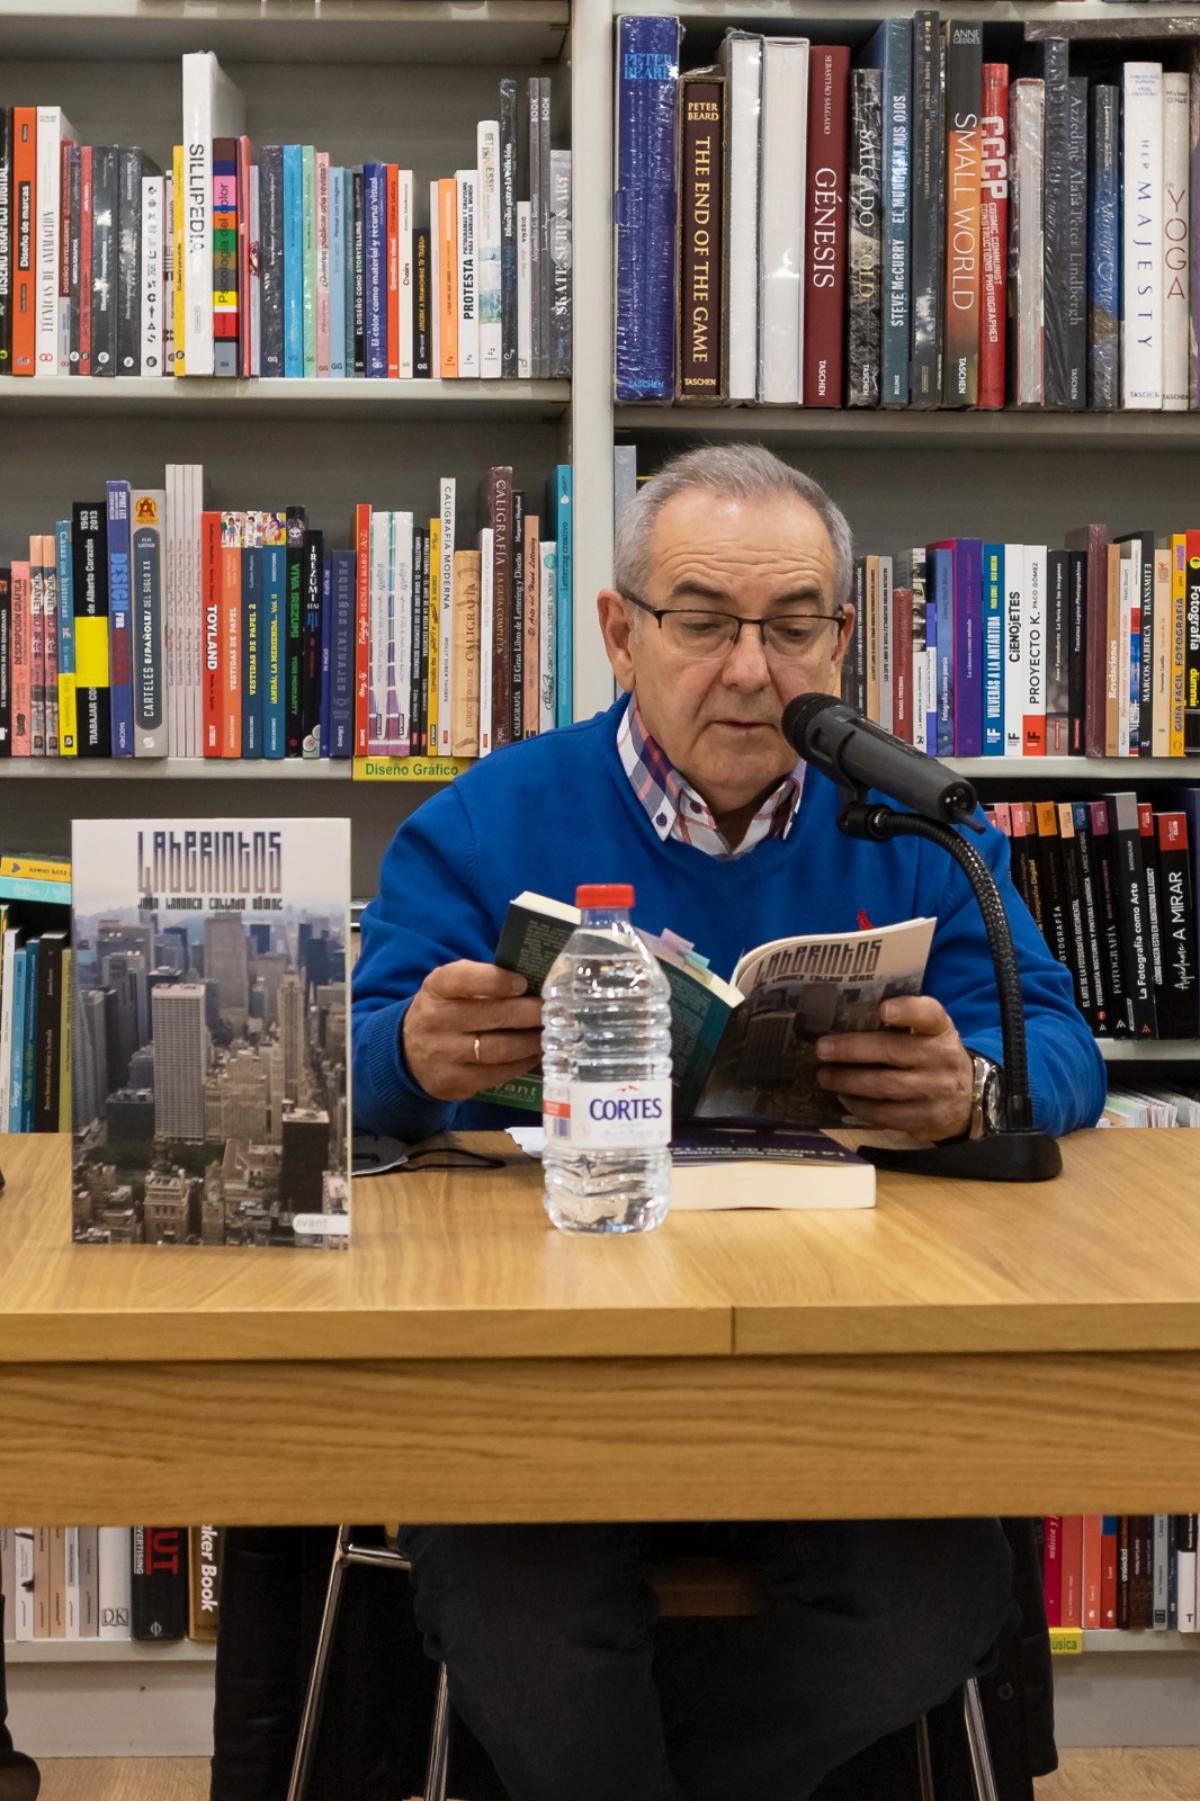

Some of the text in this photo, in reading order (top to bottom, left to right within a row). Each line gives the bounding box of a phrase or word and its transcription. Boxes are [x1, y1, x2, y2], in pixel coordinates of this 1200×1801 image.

[954, 28, 979, 37] ANNE
[688, 102, 718, 112] PETER
[688, 112, 719, 121] BEARD
[858, 130, 876, 226] SALGADO
[892, 96, 906, 223] EL MIS OJOS
[980, 116, 1008, 198] CCCP
[218, 184, 228, 236] del color
[370, 177, 378, 202] visual
[952, 113, 977, 309] SMALL WORLD
[19, 186, 29, 267] Diseño de marcas
[813, 168, 842, 288] GÉNESIS
[988, 203, 1002, 285] COSMIC COMMUNIST
[1166, 189, 1187, 300] YOGA
[370, 249, 379, 284] material
[693, 136, 710, 362] THE END OF THE GAME
[1133, 182, 1153, 348] MAJESTY
[463, 259, 474, 319] PROTESTA
[891, 239, 905, 326] STEVE McCURRY
[1068, 253, 1084, 325] Lindbergh
[985, 274, 999, 342] PHOTOGRAPHED
[357, 327, 362, 335] EL
[685, 378, 716, 386] TASCHEN
[818, 361, 827, 396] TASCHEN
[862, 364, 871, 396] TASCHEN
[958, 357, 967, 394] TASCHEN
[1070, 368, 1078, 400] TASCHEN
[80, 511, 89, 530] 1963
[90, 511, 98, 530] 2013
[495, 480, 507, 564] CALIGRAFÍA
[85, 539, 95, 571] Corazón
[143, 561, 151, 570] XX
[443, 486, 452, 609] CALIGRAFÍA MODERNA
[513, 553, 522, 578] Diseño
[59, 532, 71, 618] Casas con historias
[86, 574, 96, 602] Alberto
[110, 554, 128, 628] DESIGN FOR
[290, 564, 299, 638] VIVA IREZUMI
[464, 583, 476, 661] CALIGRAFÍA
[513, 588, 524, 619] Lettering
[1029, 612, 1040, 624] K.
[207, 605, 217, 669] TOYLAND
[230, 636, 237, 646] DE
[249, 641, 256, 651] DE
[513, 633, 522, 651] Libro
[514, 622, 522, 630] de
[987, 616, 1001, 659] ANTÁRTIDA
[513, 654, 522, 672] Gran
[988, 662, 1000, 670] LA
[1029, 630, 1040, 704] PROYECTO
[1109, 640, 1117, 699] Revelaciones
[1142, 625, 1151, 702] MARCOS ALBERCA
[143, 667, 154, 717] CARTELES
[513, 691, 521, 736] CALIGRAFÍA
[987, 681, 1001, 718] VOLVERÁS
[89, 703, 98, 744] TRABAJAR
[365, 762, 458, 778] Diseño Gráfico
[1168, 872, 1186, 940] A MIRAR
[1106, 925, 1122, 994] FOTOGRAFÍA
[1129, 882, 1148, 999] La Fotografía como Arte
[1081, 987, 1090, 999] ARTE
[590, 1098, 662, 1120] CORTES
[201, 1565, 218, 1612] Book
